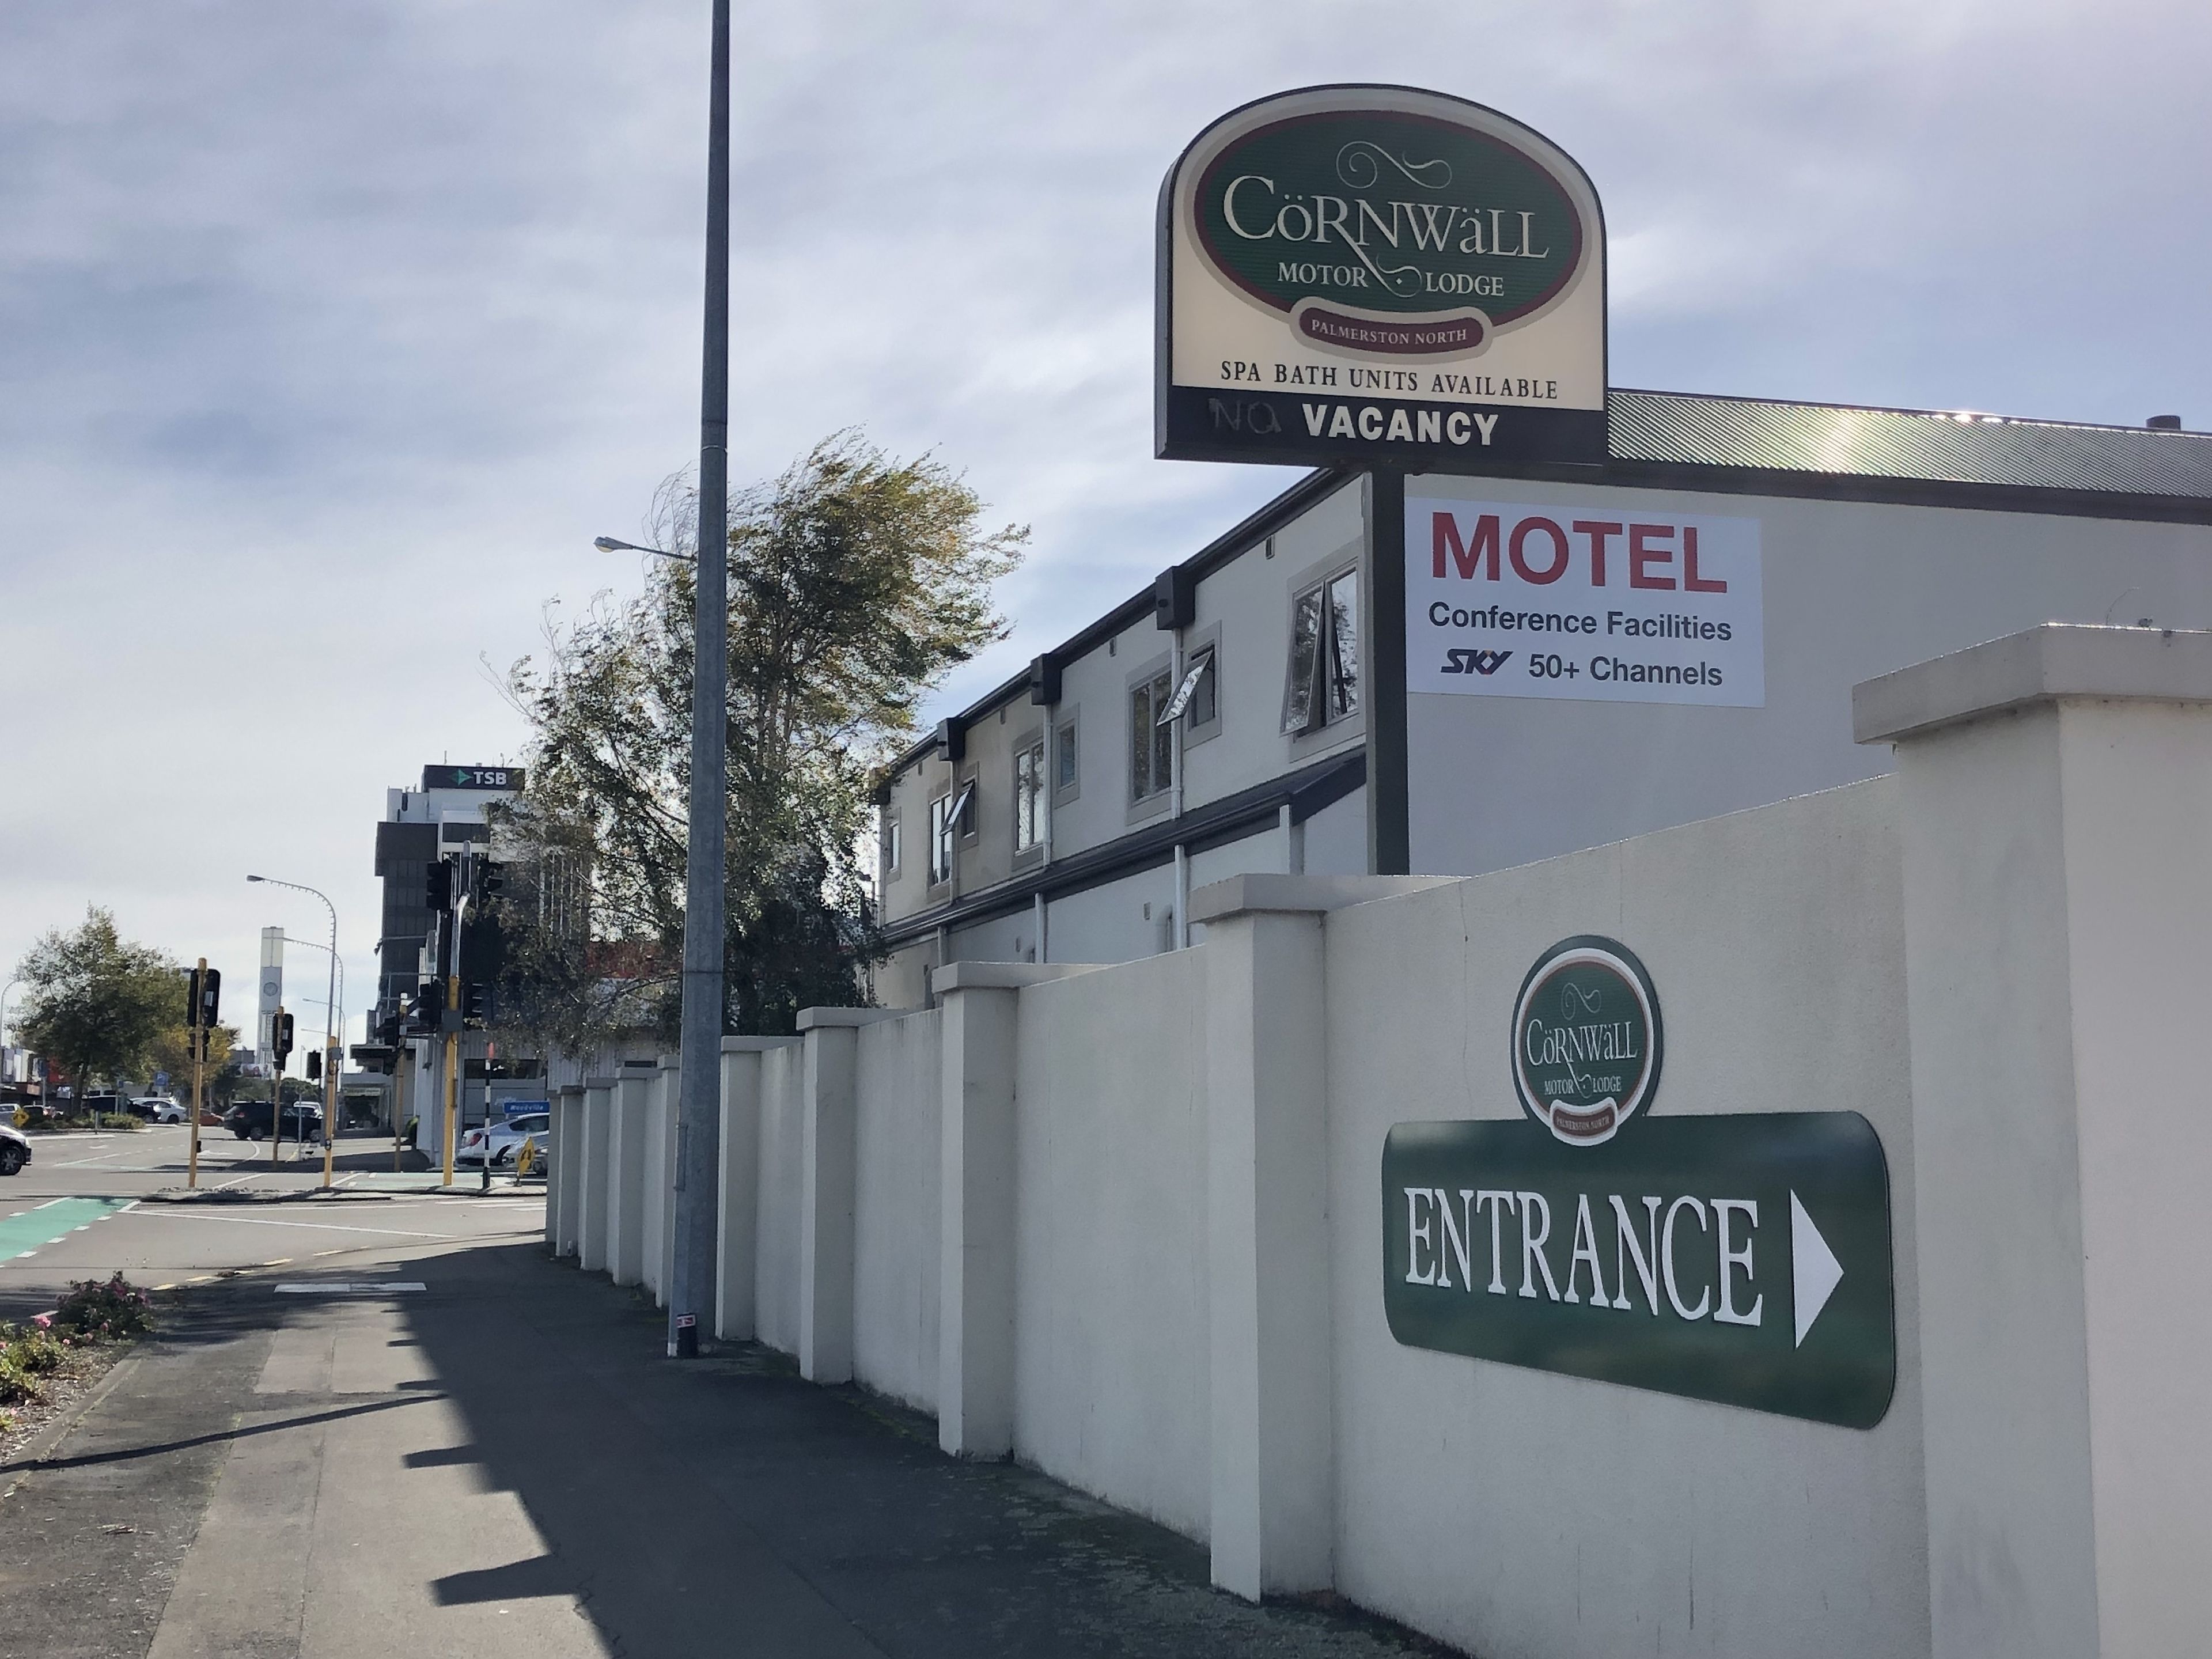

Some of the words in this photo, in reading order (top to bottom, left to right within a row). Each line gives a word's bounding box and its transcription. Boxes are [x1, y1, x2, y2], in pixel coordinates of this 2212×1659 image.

[1278, 262, 1369, 287] MOTOR
[1426, 271, 1505, 297] LODGE
[1311, 319, 1410, 344] PALMERSTON
[1415, 328, 1467, 344] NORTH
[1221, 361, 1261, 382] SPA
[1275, 364, 1337, 387] BATH
[1350, 369, 1418, 392] UNITS
[1431, 374, 1558, 400] AVAILABLE
[1302, 403, 1499, 446] VACANCY
[1432, 511, 1728, 594] MOTEL
[1428, 601, 1597, 634] Conference
[1607, 611, 1732, 641] Facilities
[1440, 647, 1514, 675] SKY
[1529, 653, 1580, 679] 50+
[1590, 656, 1723, 686] Channels
[473, 771, 507, 785] TSB
[1544, 1079, 1575, 1096] MOTOR
[1593, 1075, 1622, 1093] LODGE
[1403, 1187, 1763, 1327] ENTRANCE
